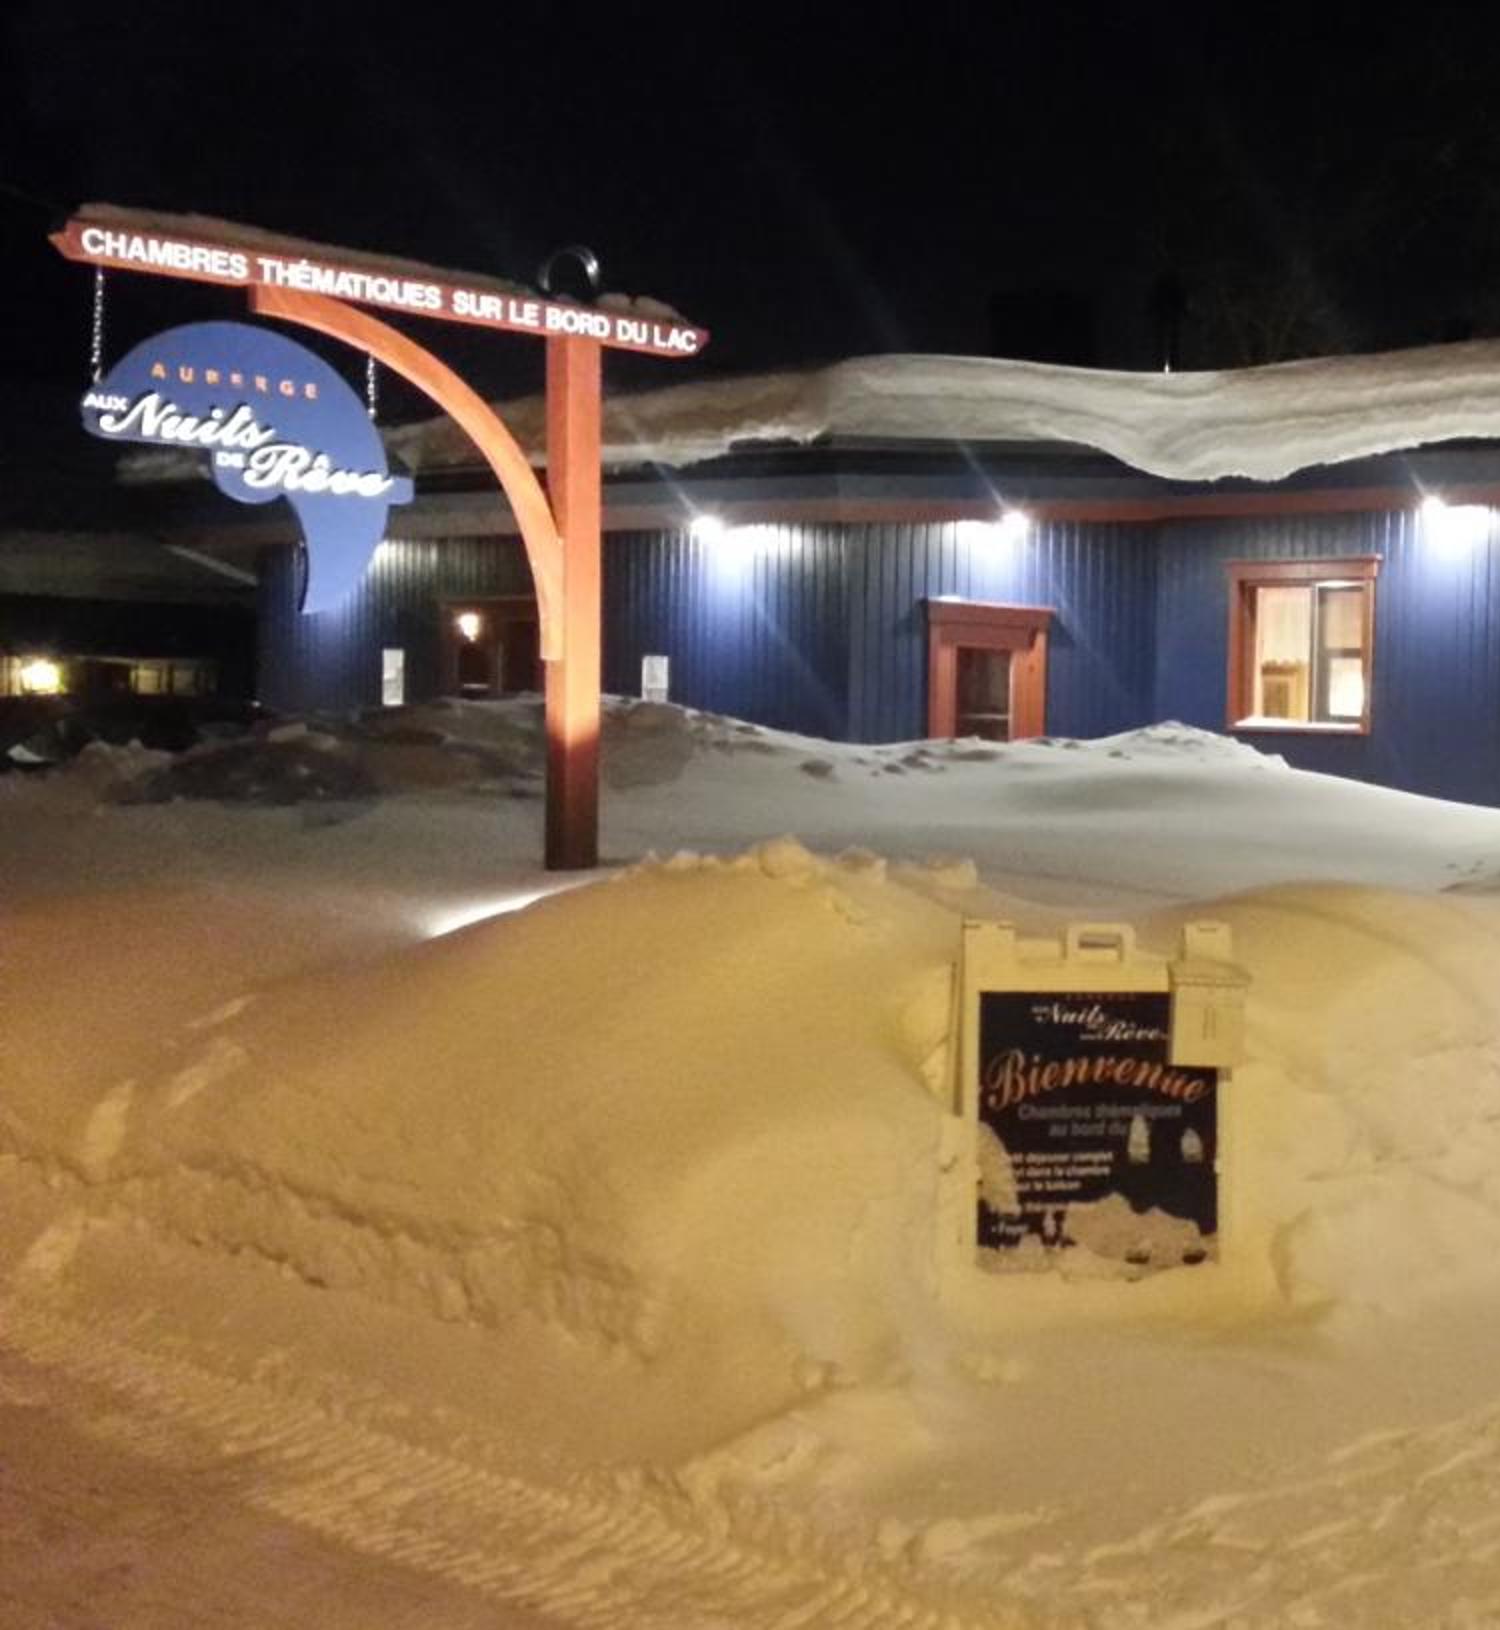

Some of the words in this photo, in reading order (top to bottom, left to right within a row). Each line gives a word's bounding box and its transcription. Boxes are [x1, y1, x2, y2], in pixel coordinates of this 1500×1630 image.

[81, 228, 248, 279] CHAMBRES
[256, 258, 442, 310] THÉMATIQUES
[452, 291, 502, 320] SUR
[509, 300, 539, 326] LE
[546, 306, 611, 338] BORD
[616, 319, 649, 344] DU
[653, 325, 697, 352] LAC
[151, 362, 319, 400] AUBERGE
[83, 393, 128, 411] AUX
[216, 451, 245, 468] DE
[244, 444, 394, 497] Rêve
[1100, 1018, 1167, 1042] Rêve
[986, 1047, 1209, 1108] Bienvenue
[1018, 1102, 1091, 1120] Chambres
